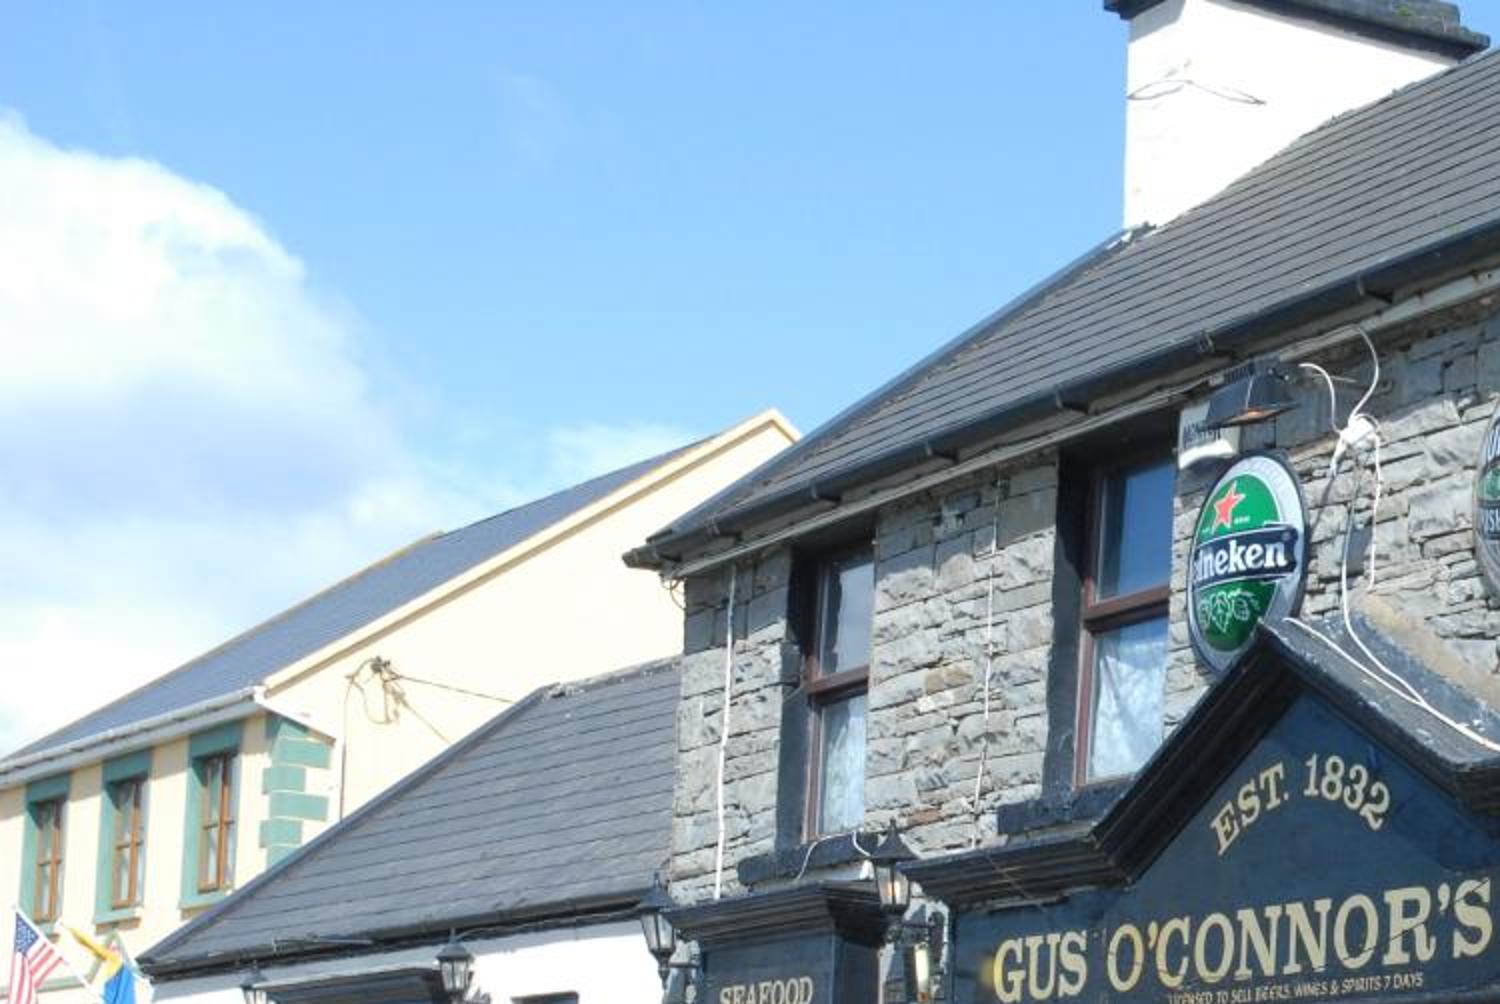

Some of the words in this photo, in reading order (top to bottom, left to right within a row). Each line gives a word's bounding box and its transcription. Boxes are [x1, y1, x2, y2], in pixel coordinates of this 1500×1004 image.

[1194, 538, 1288, 581] ineken
[1210, 760, 1289, 856] EST.
[1304, 753, 1392, 832] 1832
[993, 928, 1088, 1004] GUS
[1106, 877, 1494, 992] O'CONNOR'S
[1217, 989, 1229, 1004] TO
[1231, 987, 1252, 1004] SELL
[1294, 978, 1329, 998] WINES
[1329, 978, 1339, 995] &
[1341, 975, 1381, 994] SPIRITS
[1393, 971, 1425, 990] DAYS
